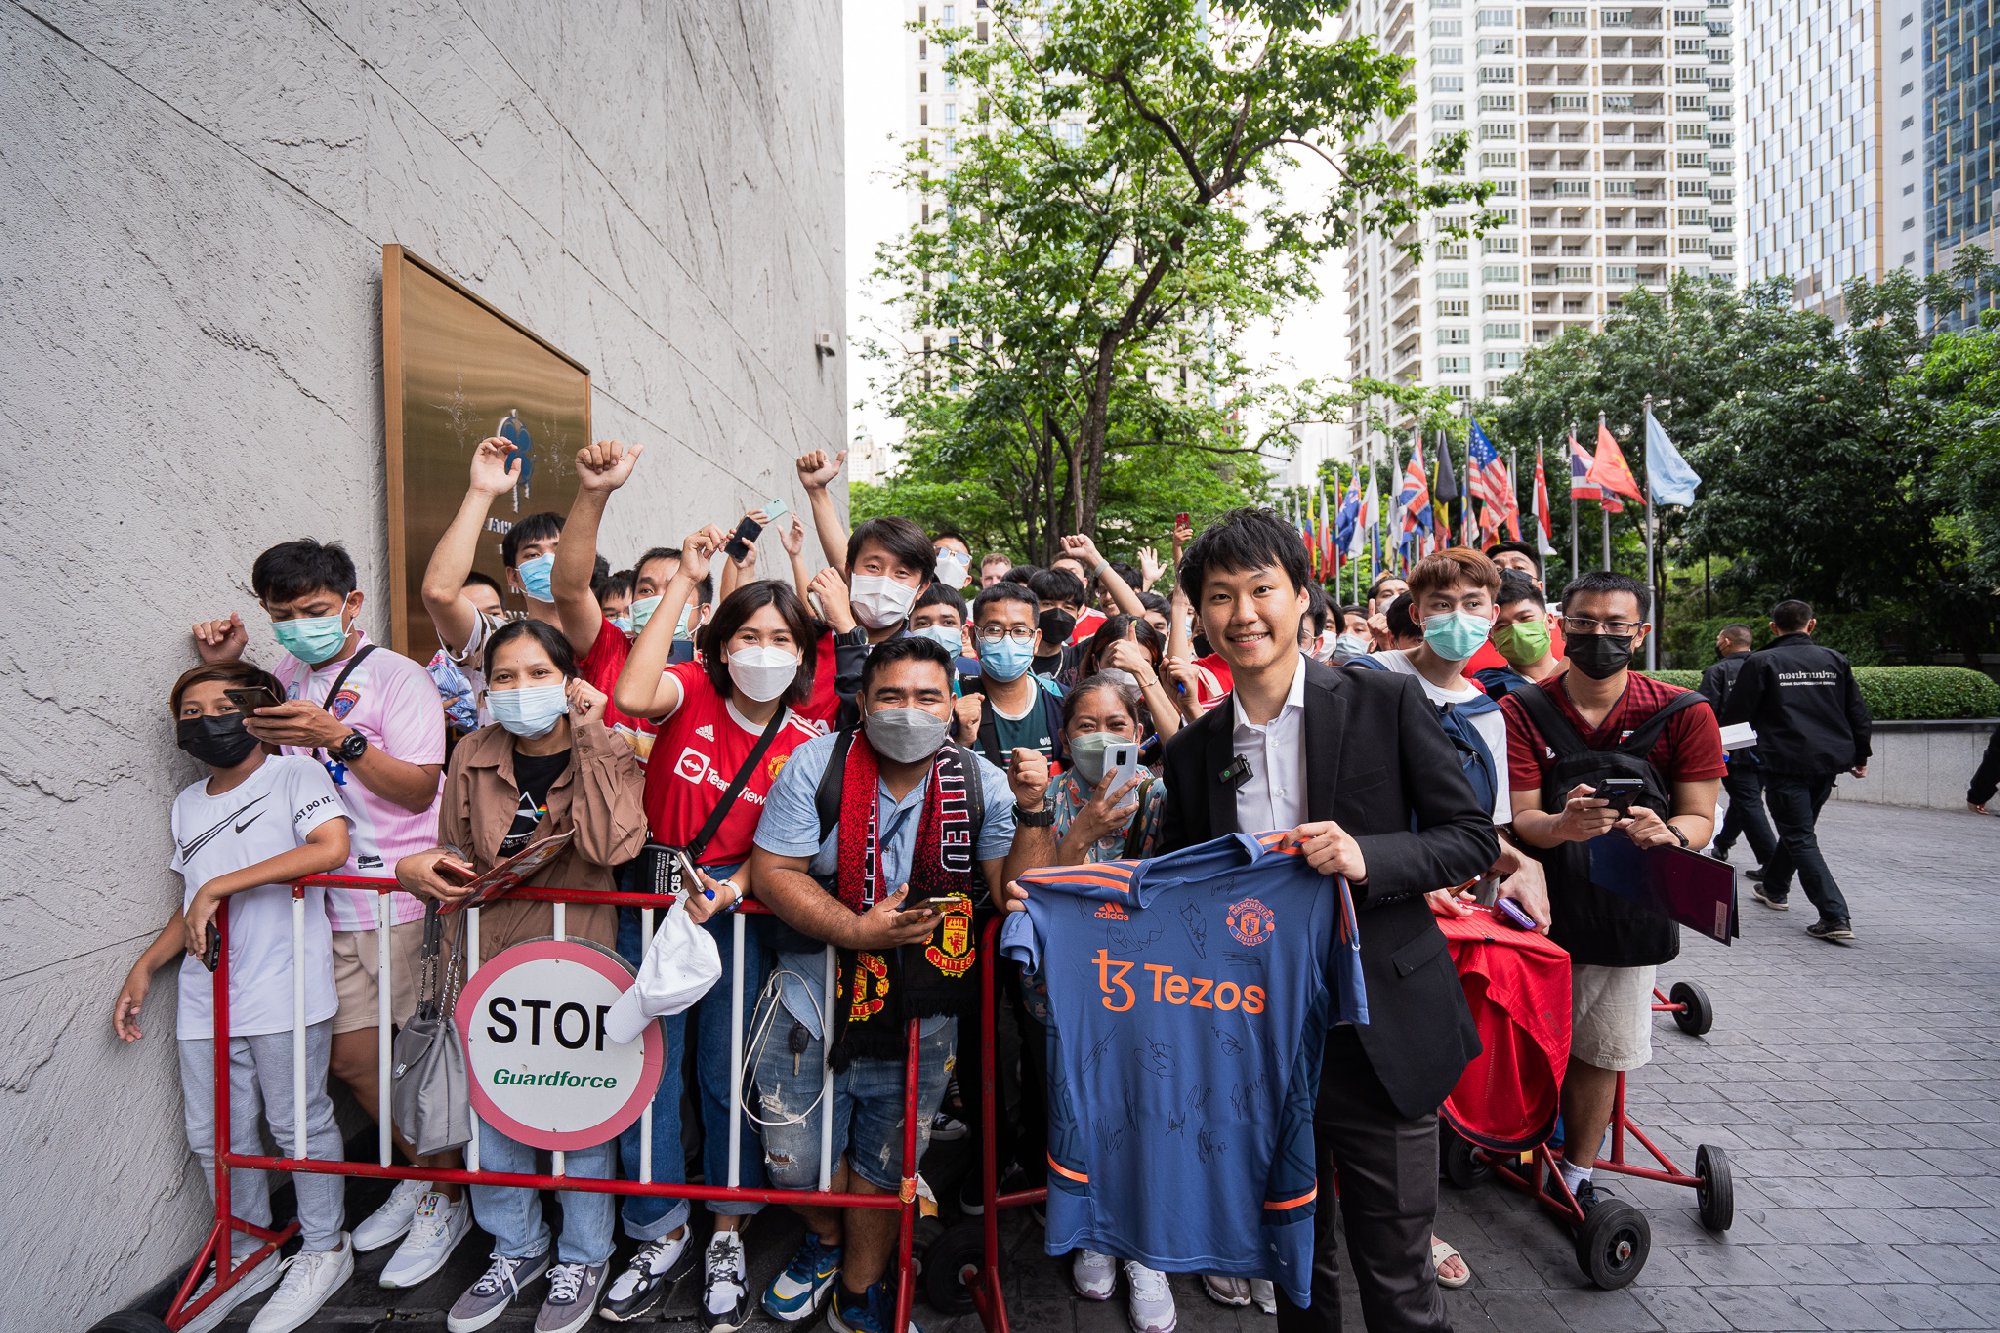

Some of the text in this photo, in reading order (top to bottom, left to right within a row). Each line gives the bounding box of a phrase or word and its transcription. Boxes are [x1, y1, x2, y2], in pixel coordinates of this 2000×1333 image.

[293, 795, 335, 824] UST DO IT.
[935, 735, 972, 872] NITED
[1093, 911, 1129, 921] adidas
[1232, 901, 1270, 919] MANCHESTER
[1236, 932, 1263, 943] UNITED
[933, 954, 972, 970] UNITED
[1144, 963, 1266, 1014] Tezos
[851, 1003, 875, 1014] ITED
[493, 1068, 618, 1089] Guardforce
